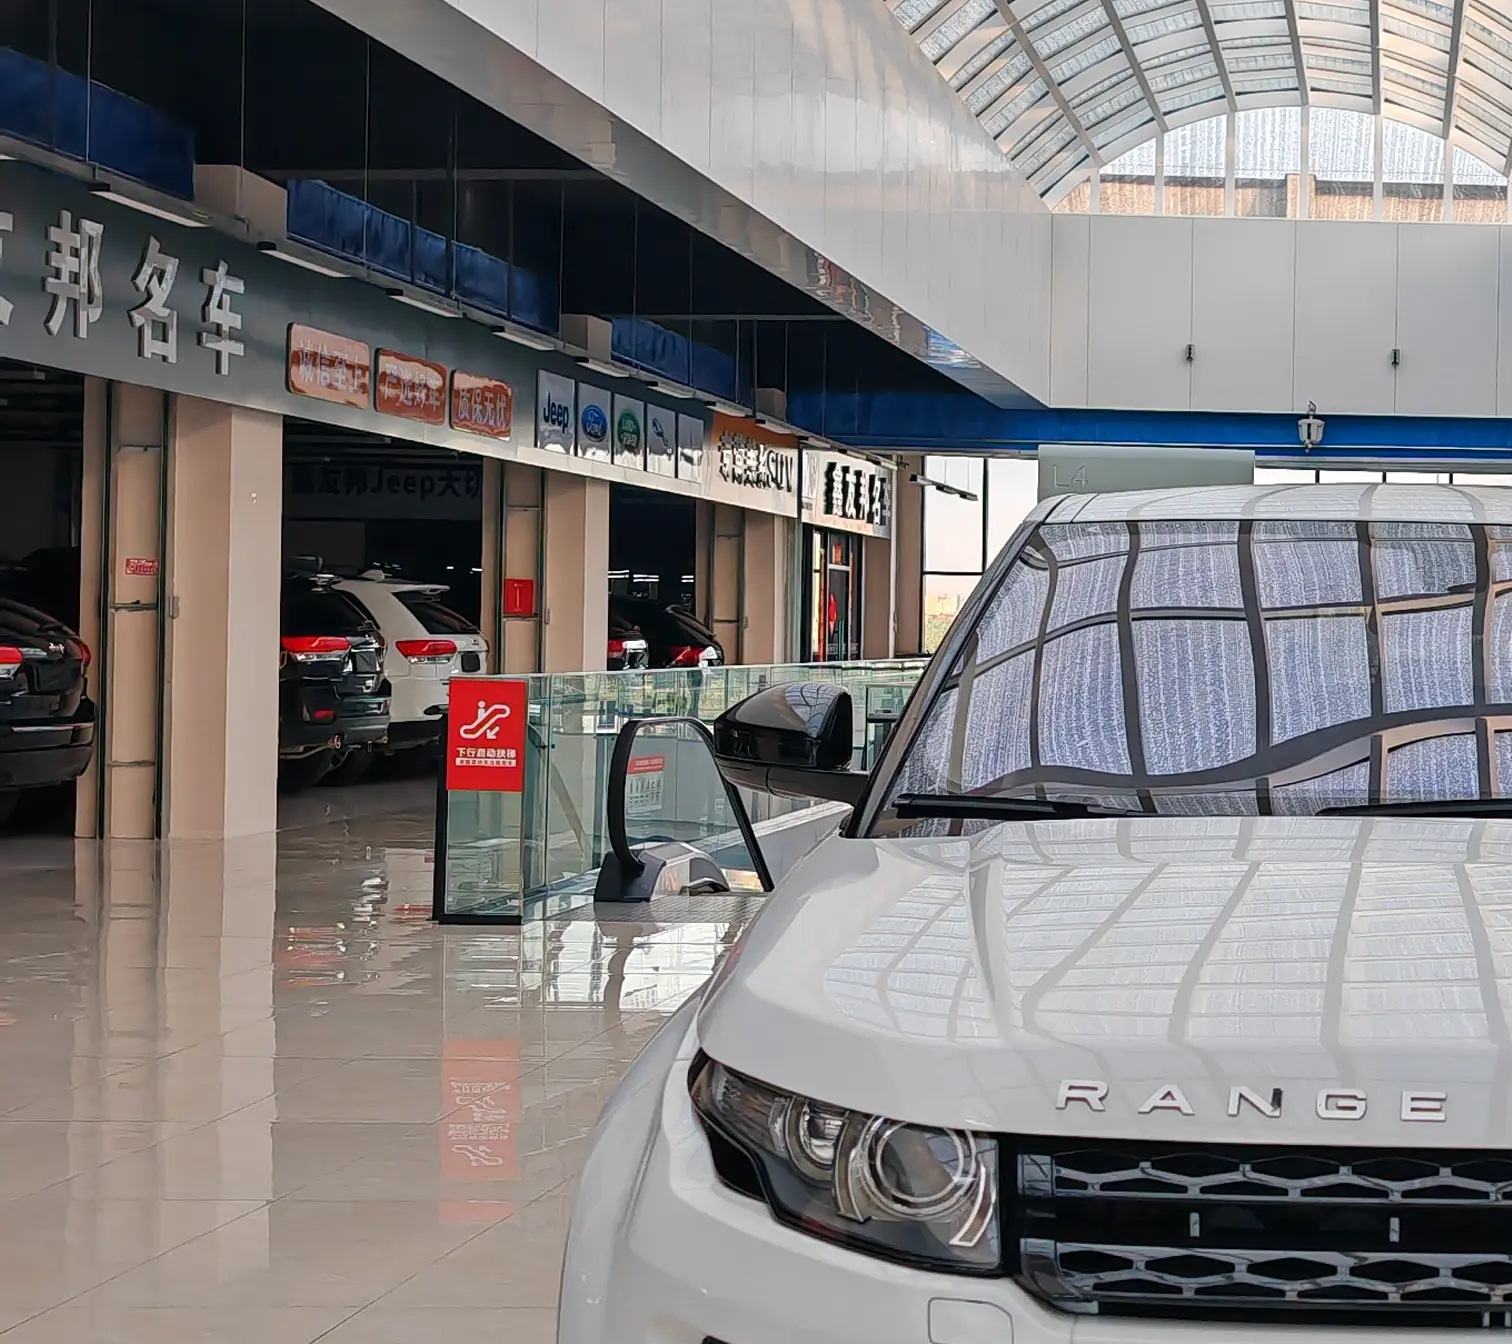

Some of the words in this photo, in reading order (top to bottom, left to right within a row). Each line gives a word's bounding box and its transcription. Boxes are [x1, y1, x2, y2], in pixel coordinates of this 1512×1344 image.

[0, 210, 245, 376] 邦名车
[543, 391, 570, 435] Jeep
[1053, 463, 1088, 488] L4
[1054, 1078, 1448, 1123] RANGE
